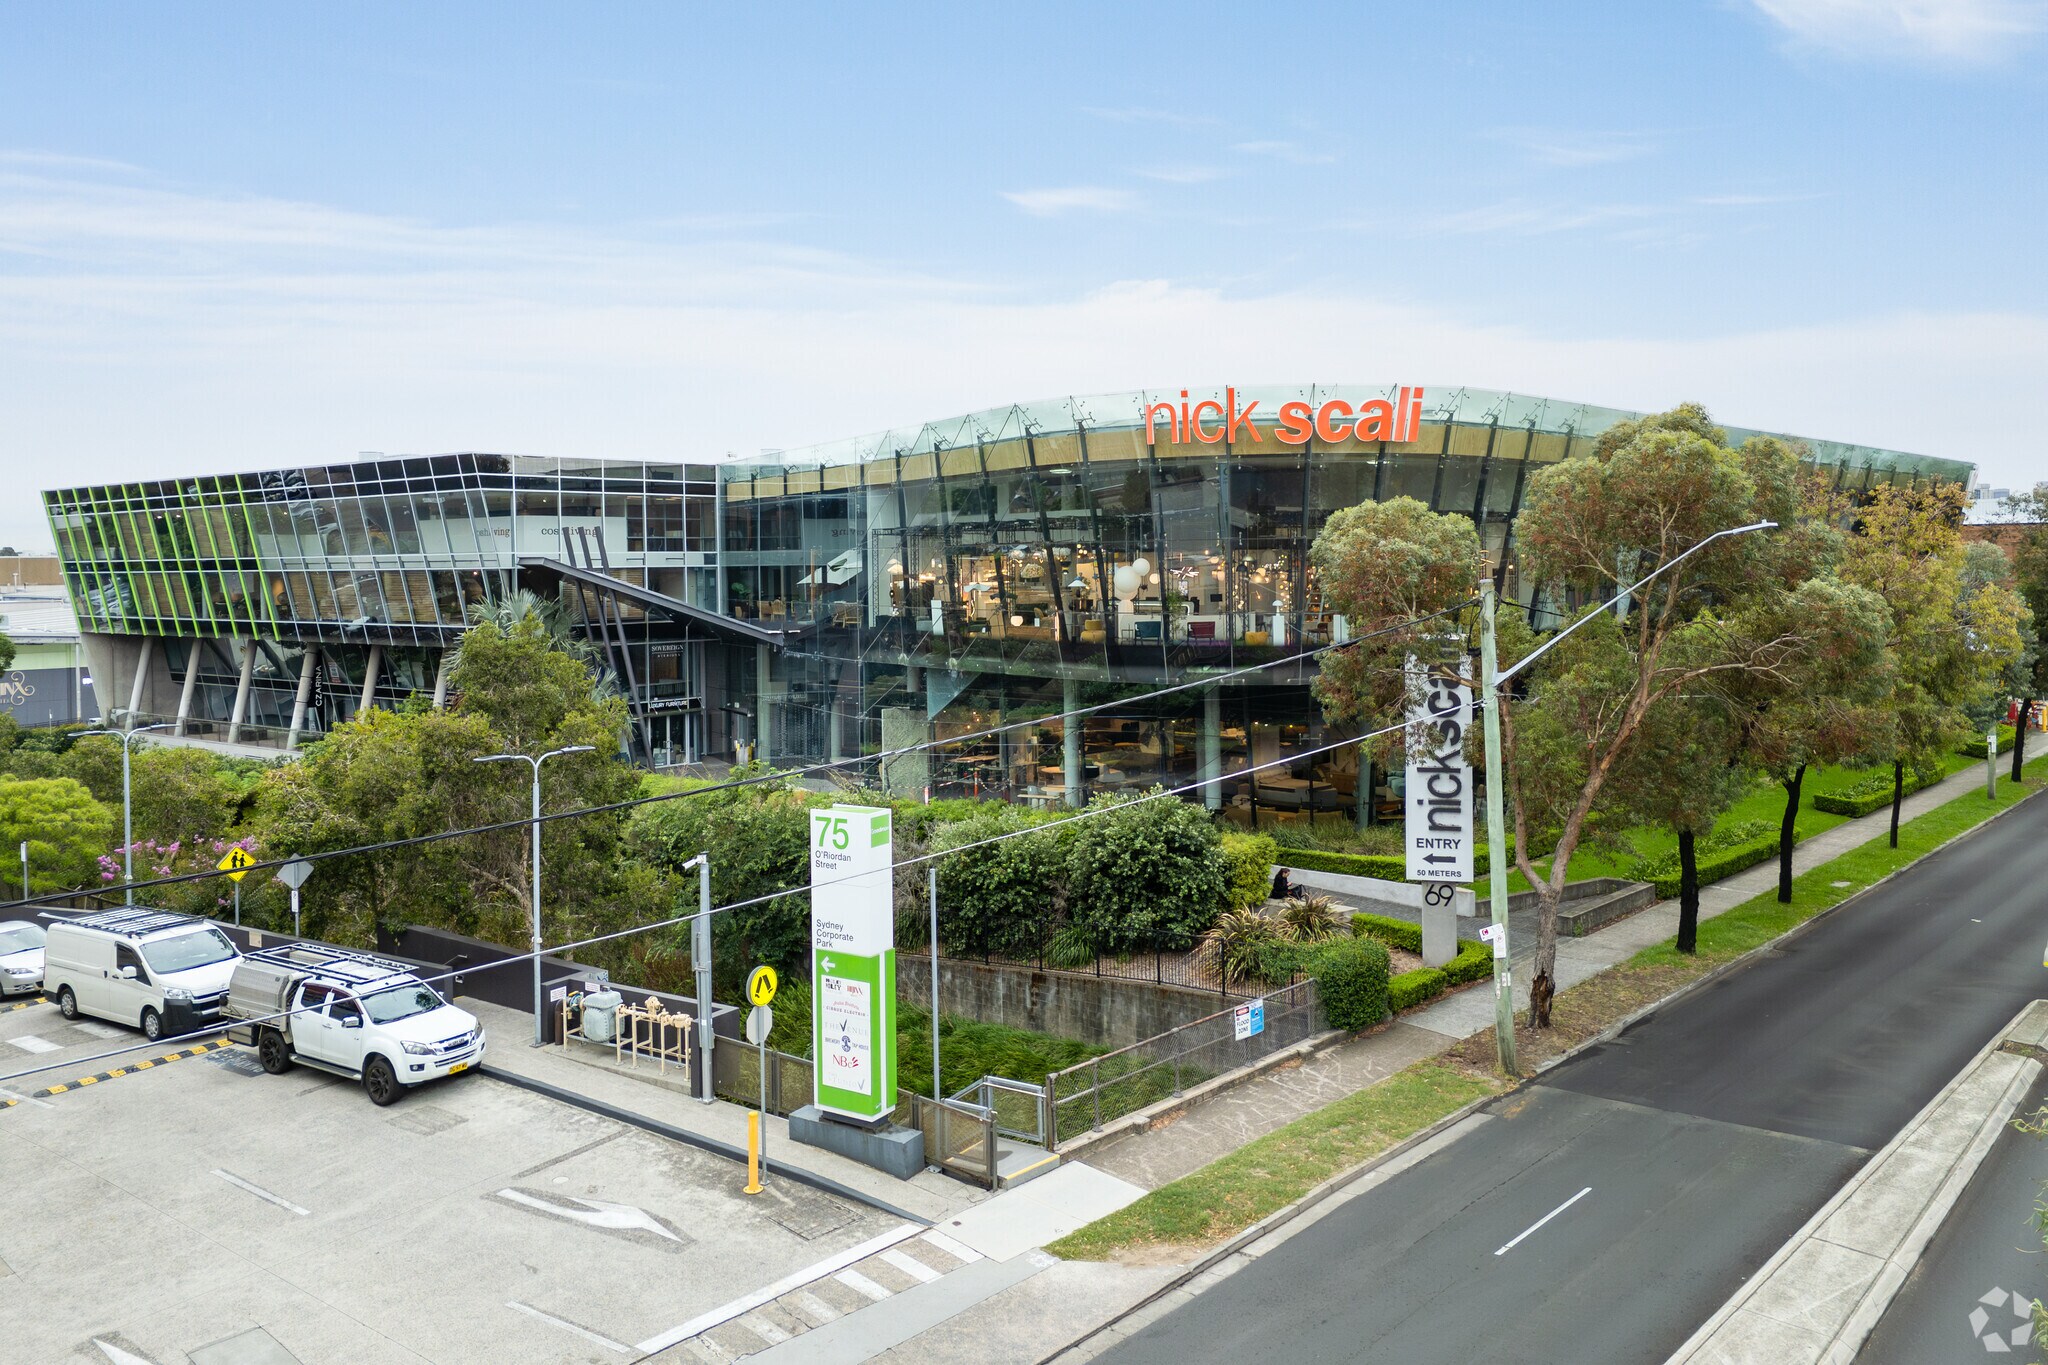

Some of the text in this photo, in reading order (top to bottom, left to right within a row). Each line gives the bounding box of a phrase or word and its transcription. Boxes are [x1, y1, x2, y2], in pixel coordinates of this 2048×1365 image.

[1145, 386, 1425, 445] nick scali
[315, 665, 323, 707] CZARINA
[815, 816, 850, 850] 75
[1416, 837, 1462, 850] ENTRY
[815, 850, 852, 862] O'Riordan
[815, 860, 837, 870] Street
[1428, 870, 1462, 878] METERS
[1425, 884, 1454, 907] 69
[816, 919, 844, 932] Sydney
[816, 929, 854, 942] Corporate
[816, 938, 833, 949] Park
